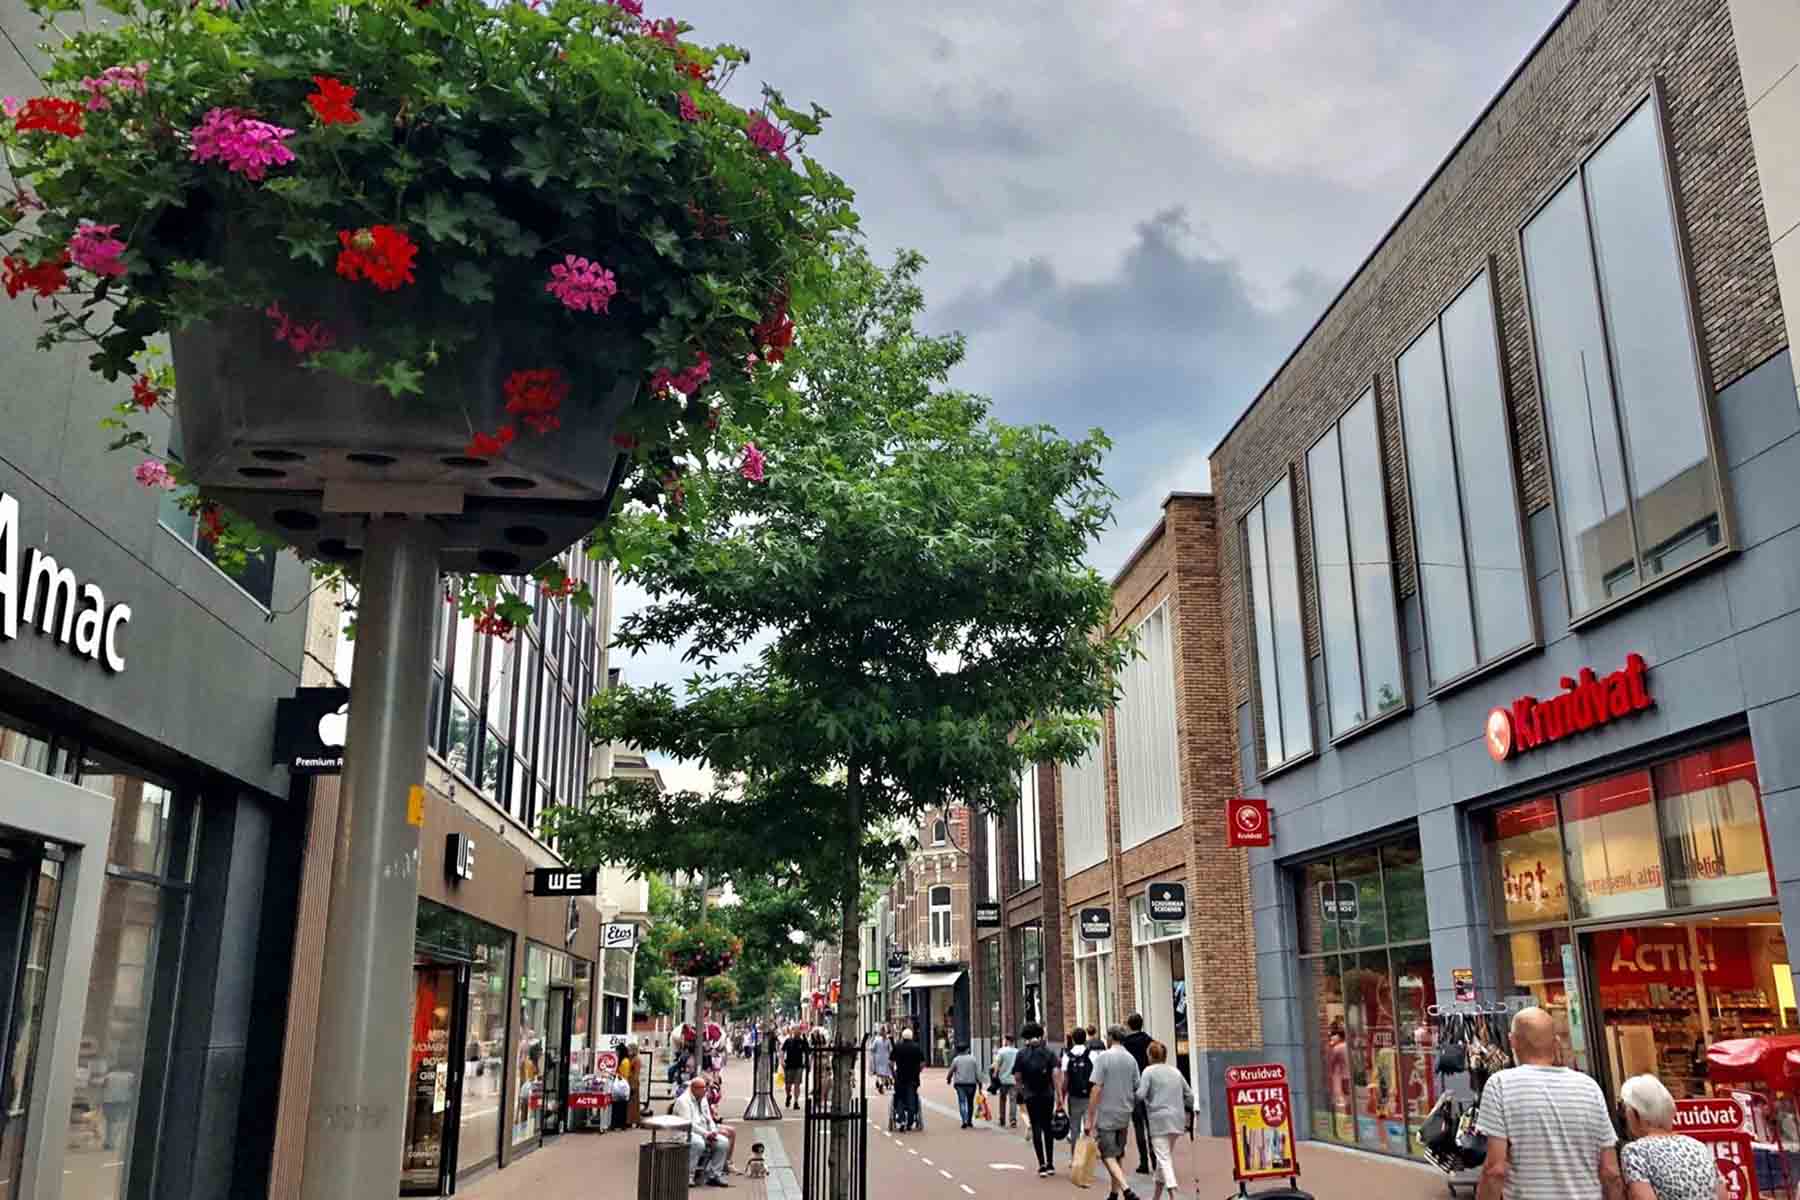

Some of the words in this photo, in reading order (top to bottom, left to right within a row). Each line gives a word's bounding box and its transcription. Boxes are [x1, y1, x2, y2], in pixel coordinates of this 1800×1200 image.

[0, 492, 132, 672] Amac
[1512, 652, 1653, 752] Kruidvat
[295, 757, 335, 767] Premium
[548, 873, 582, 890] WE
[607, 925, 632, 939] Etos
[1240, 1068, 1282, 1080] Kruidvat
[1237, 1088, 1284, 1103] ACTIE!
